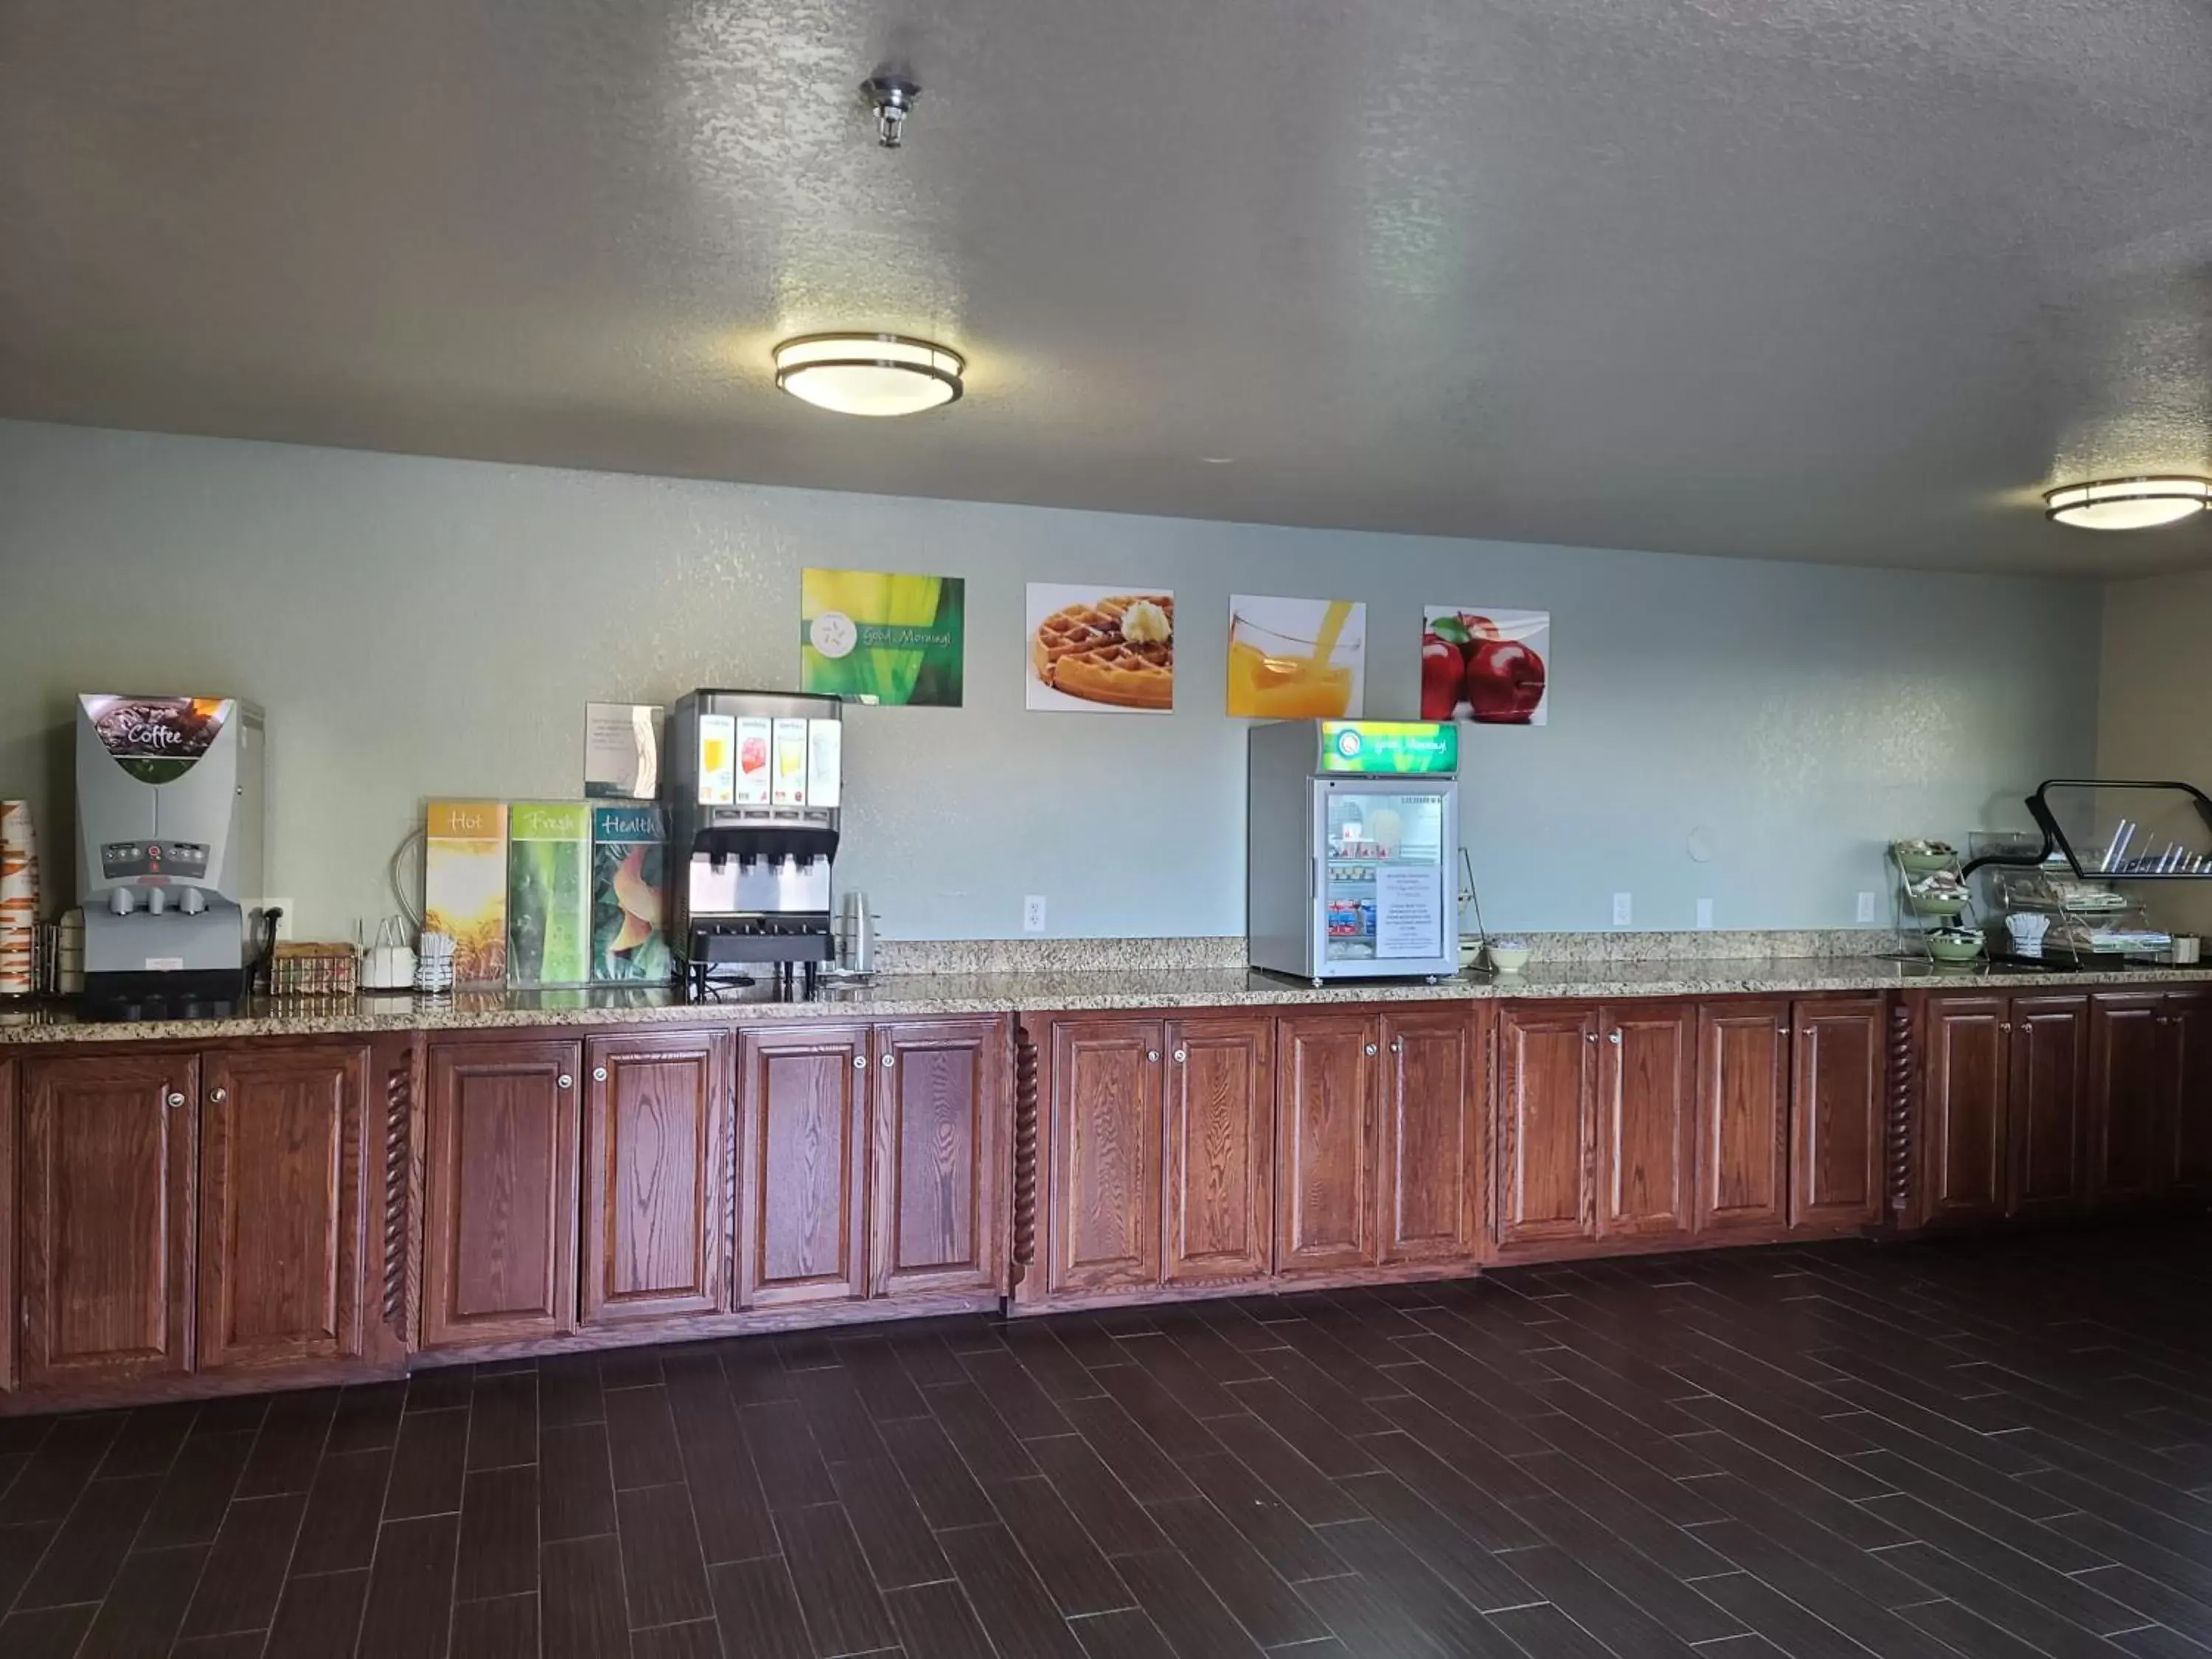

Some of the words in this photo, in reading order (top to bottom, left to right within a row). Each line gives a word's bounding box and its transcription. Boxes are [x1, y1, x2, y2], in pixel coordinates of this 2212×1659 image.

[863, 627, 891, 645] Good
[128, 724, 183, 748] Coffee
[448, 809, 483, 833] Hot
[523, 809, 575, 835] Fresh
